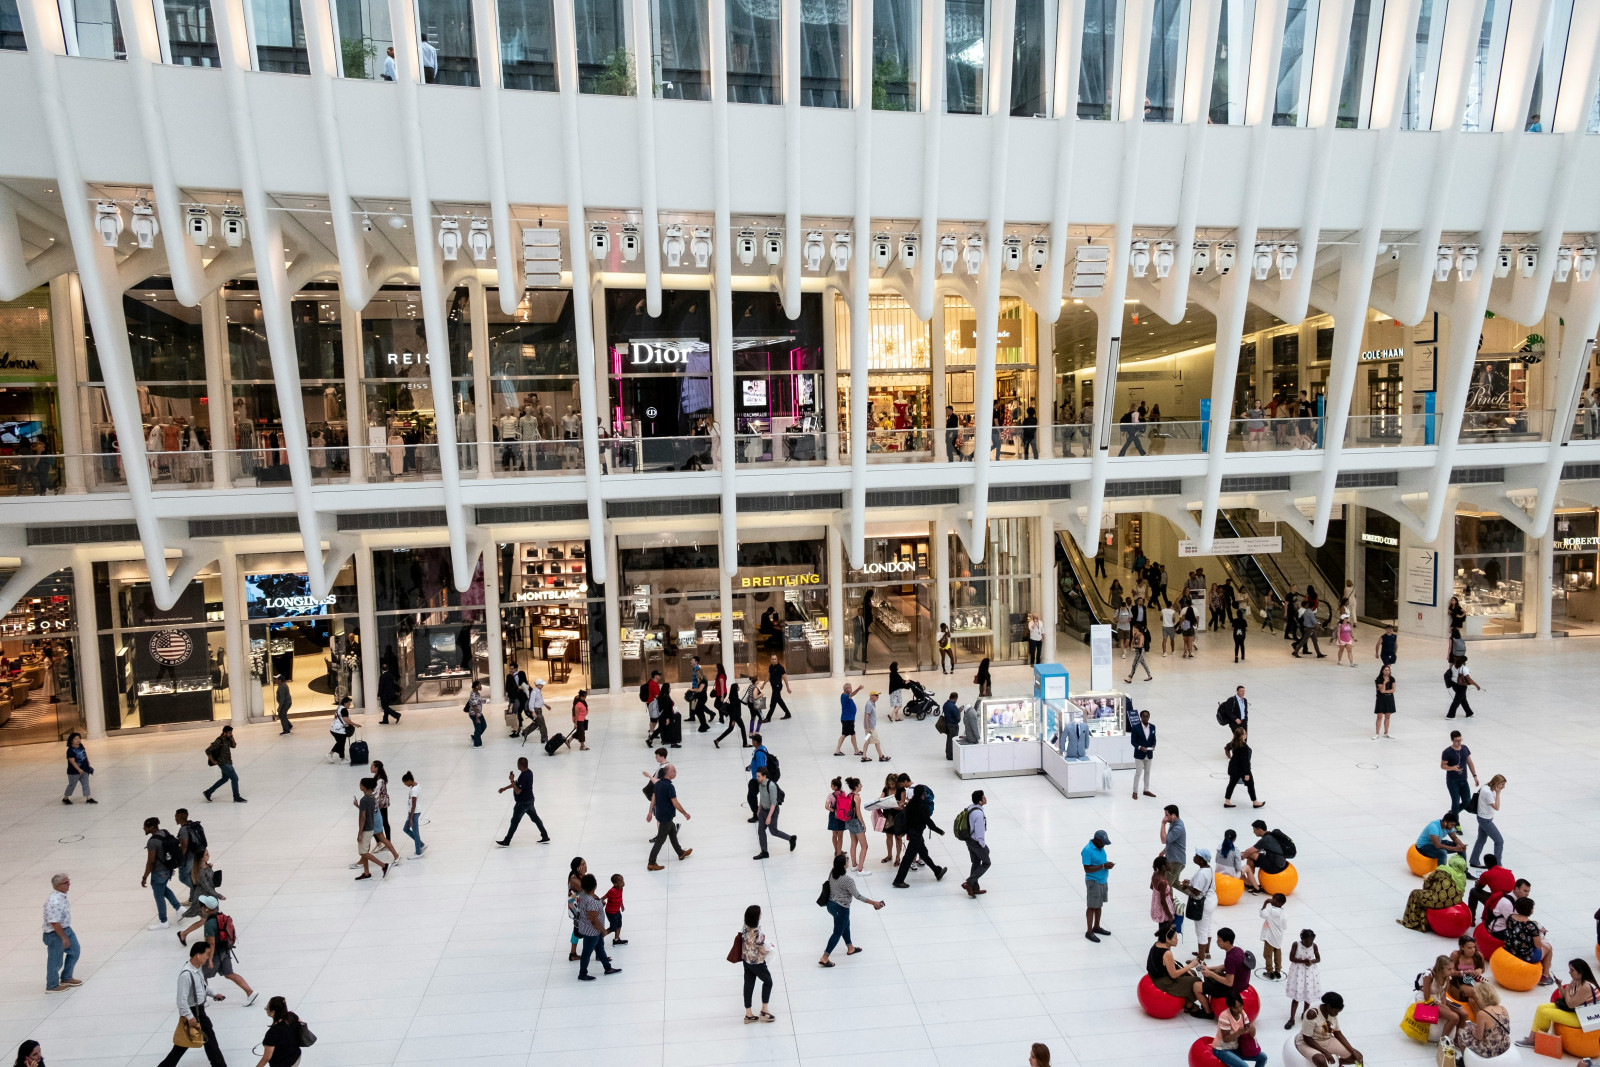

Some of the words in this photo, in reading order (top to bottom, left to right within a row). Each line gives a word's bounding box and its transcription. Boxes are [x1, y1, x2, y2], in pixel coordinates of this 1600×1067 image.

[630, 342, 692, 364] Dior
[1362, 351, 1381, 360] COLE
[1383, 347, 1404, 358] HAAN
[1384, 536, 1398, 546] COIN
[863, 561, 916, 574] LONDON
[741, 574, 820, 588] BREITLING
[516, 589, 580, 602] MONTBLANC
